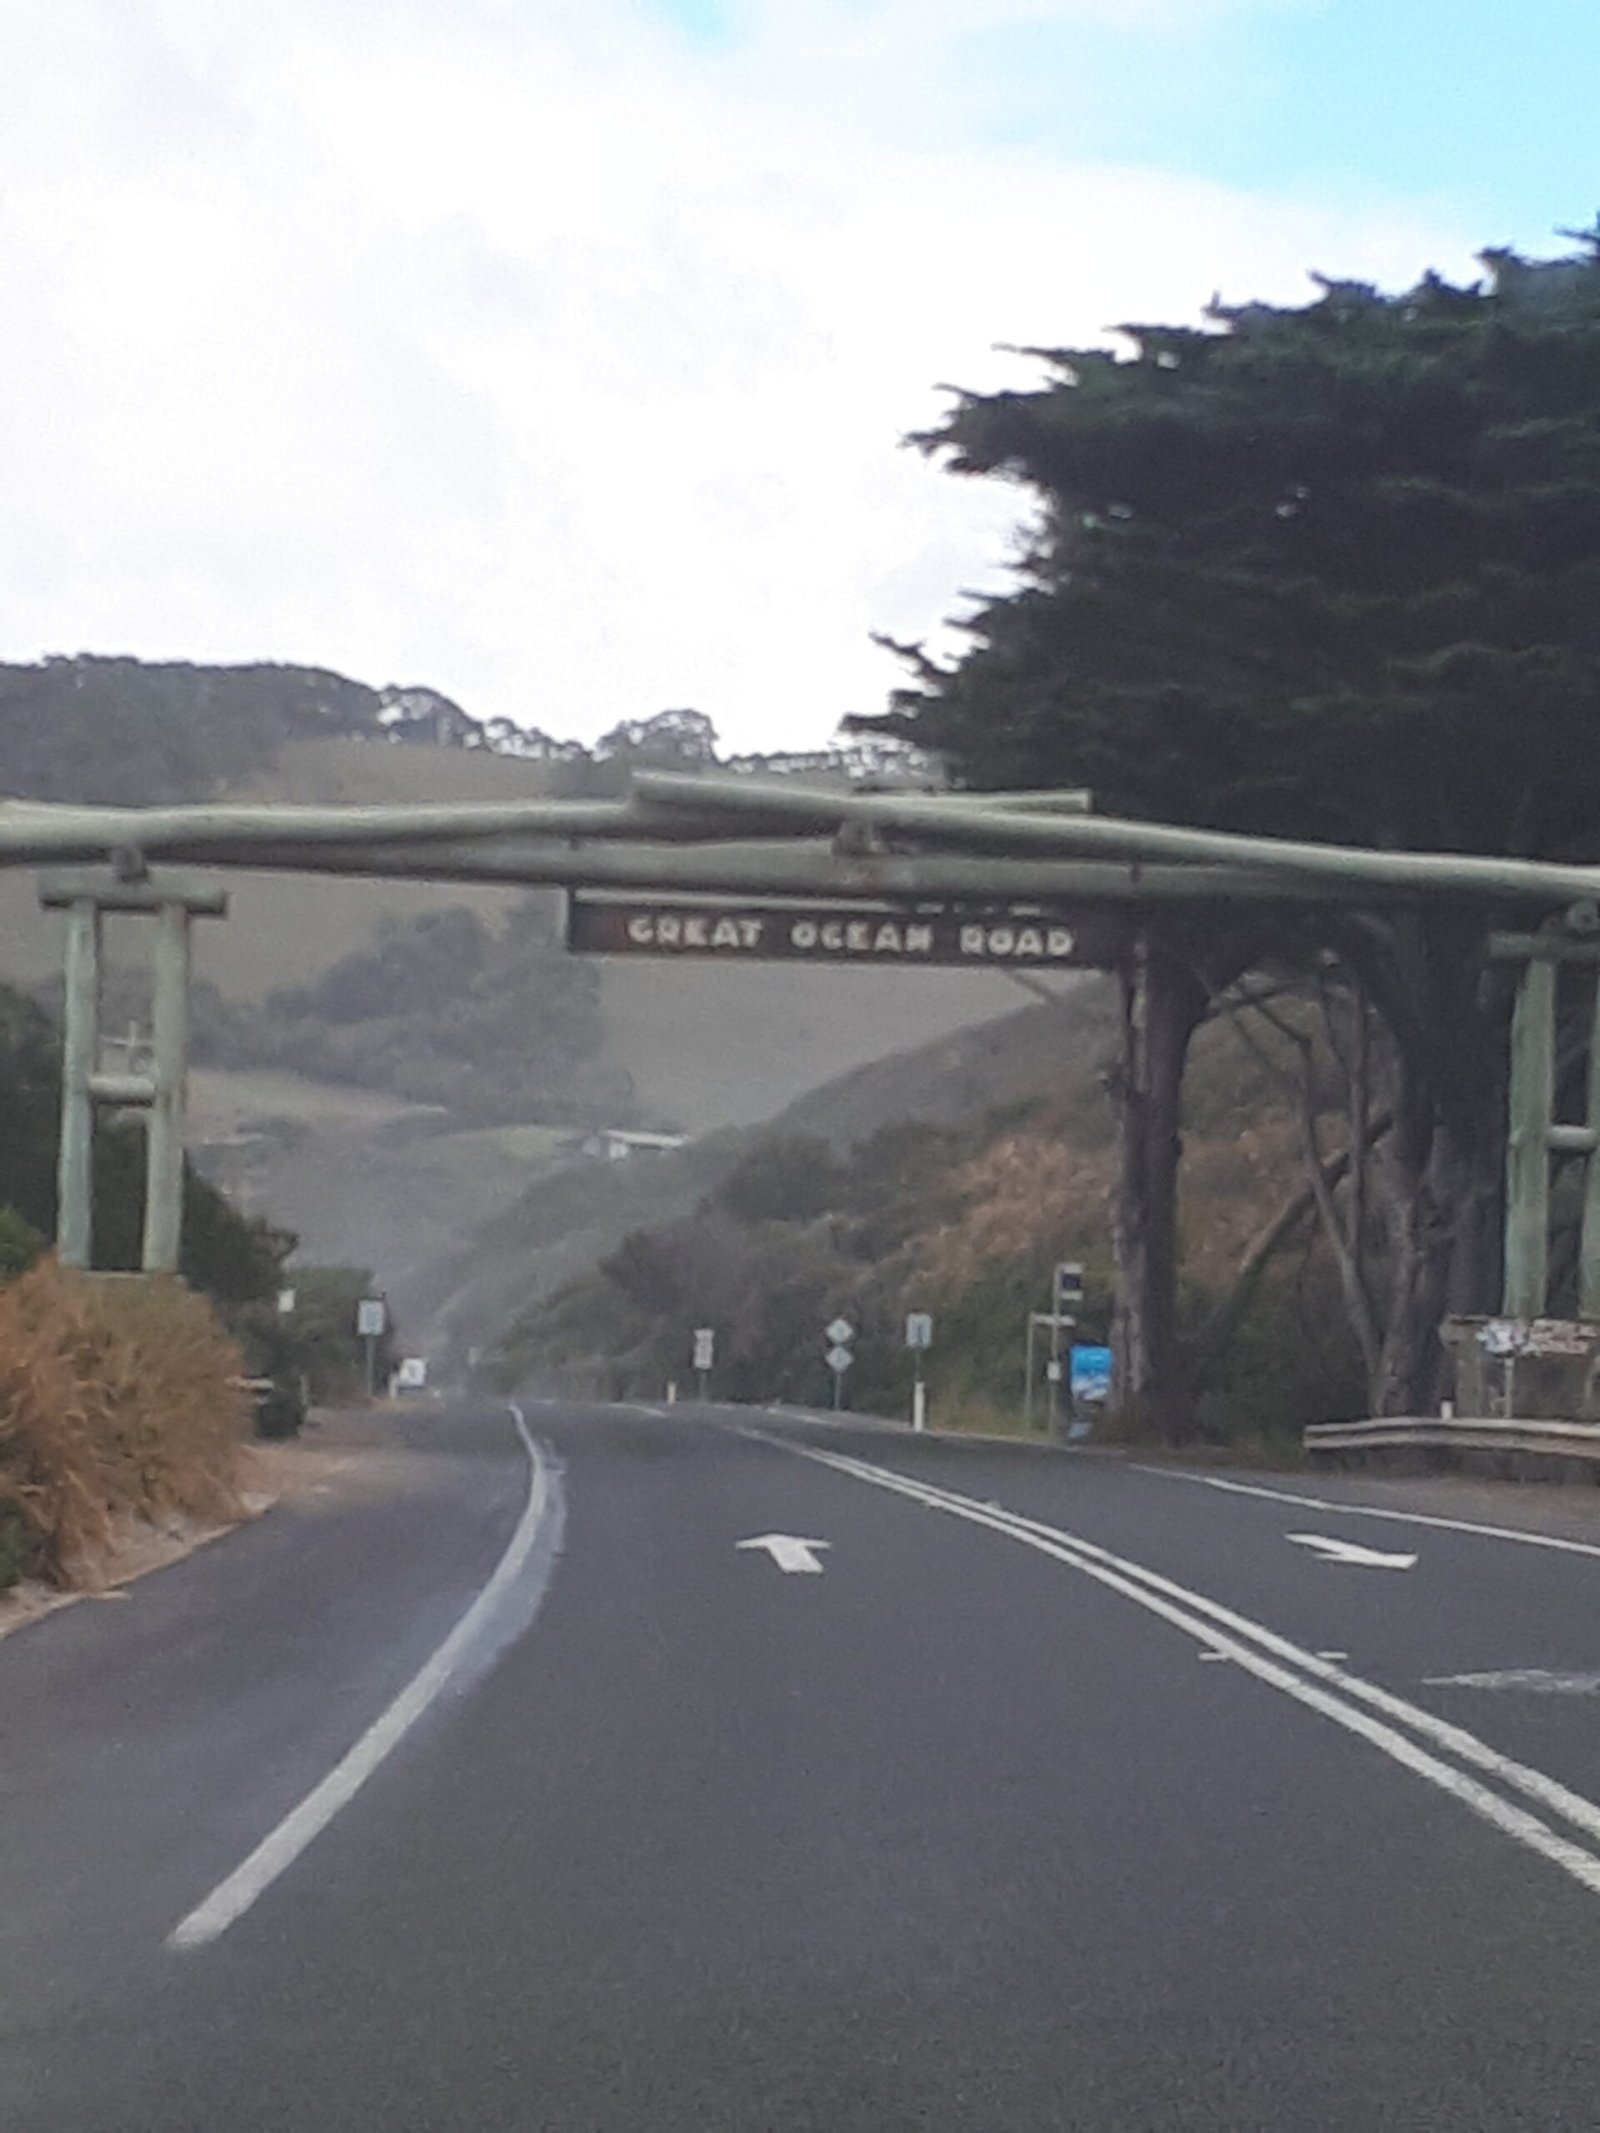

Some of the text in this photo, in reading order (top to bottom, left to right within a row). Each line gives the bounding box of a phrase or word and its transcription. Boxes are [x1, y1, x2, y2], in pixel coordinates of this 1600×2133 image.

[627, 915, 1074, 956] GREAT OCEAN ROAD
